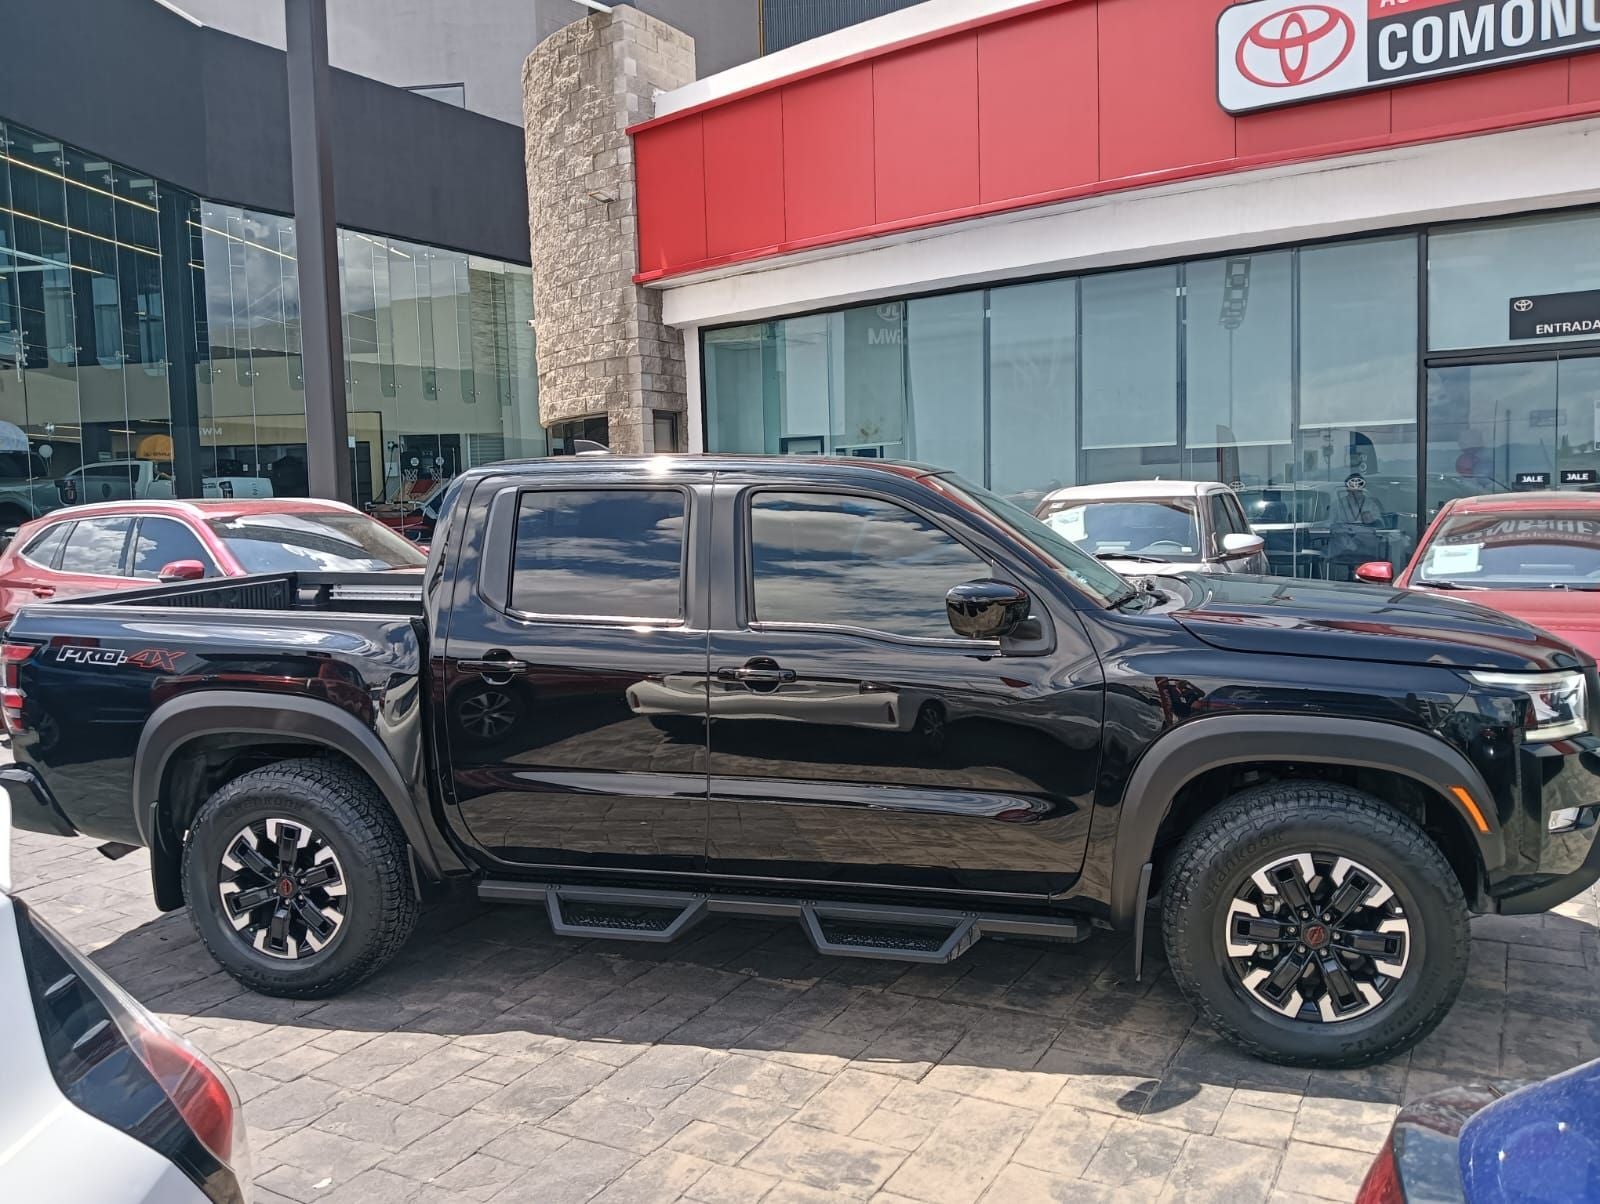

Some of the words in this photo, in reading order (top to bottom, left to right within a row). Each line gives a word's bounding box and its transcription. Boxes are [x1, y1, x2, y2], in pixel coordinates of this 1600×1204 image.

[1535, 319, 1600, 335] ENTRADA
[1521, 475, 1545, 483] JALE
[1565, 472, 1590, 481] JALE
